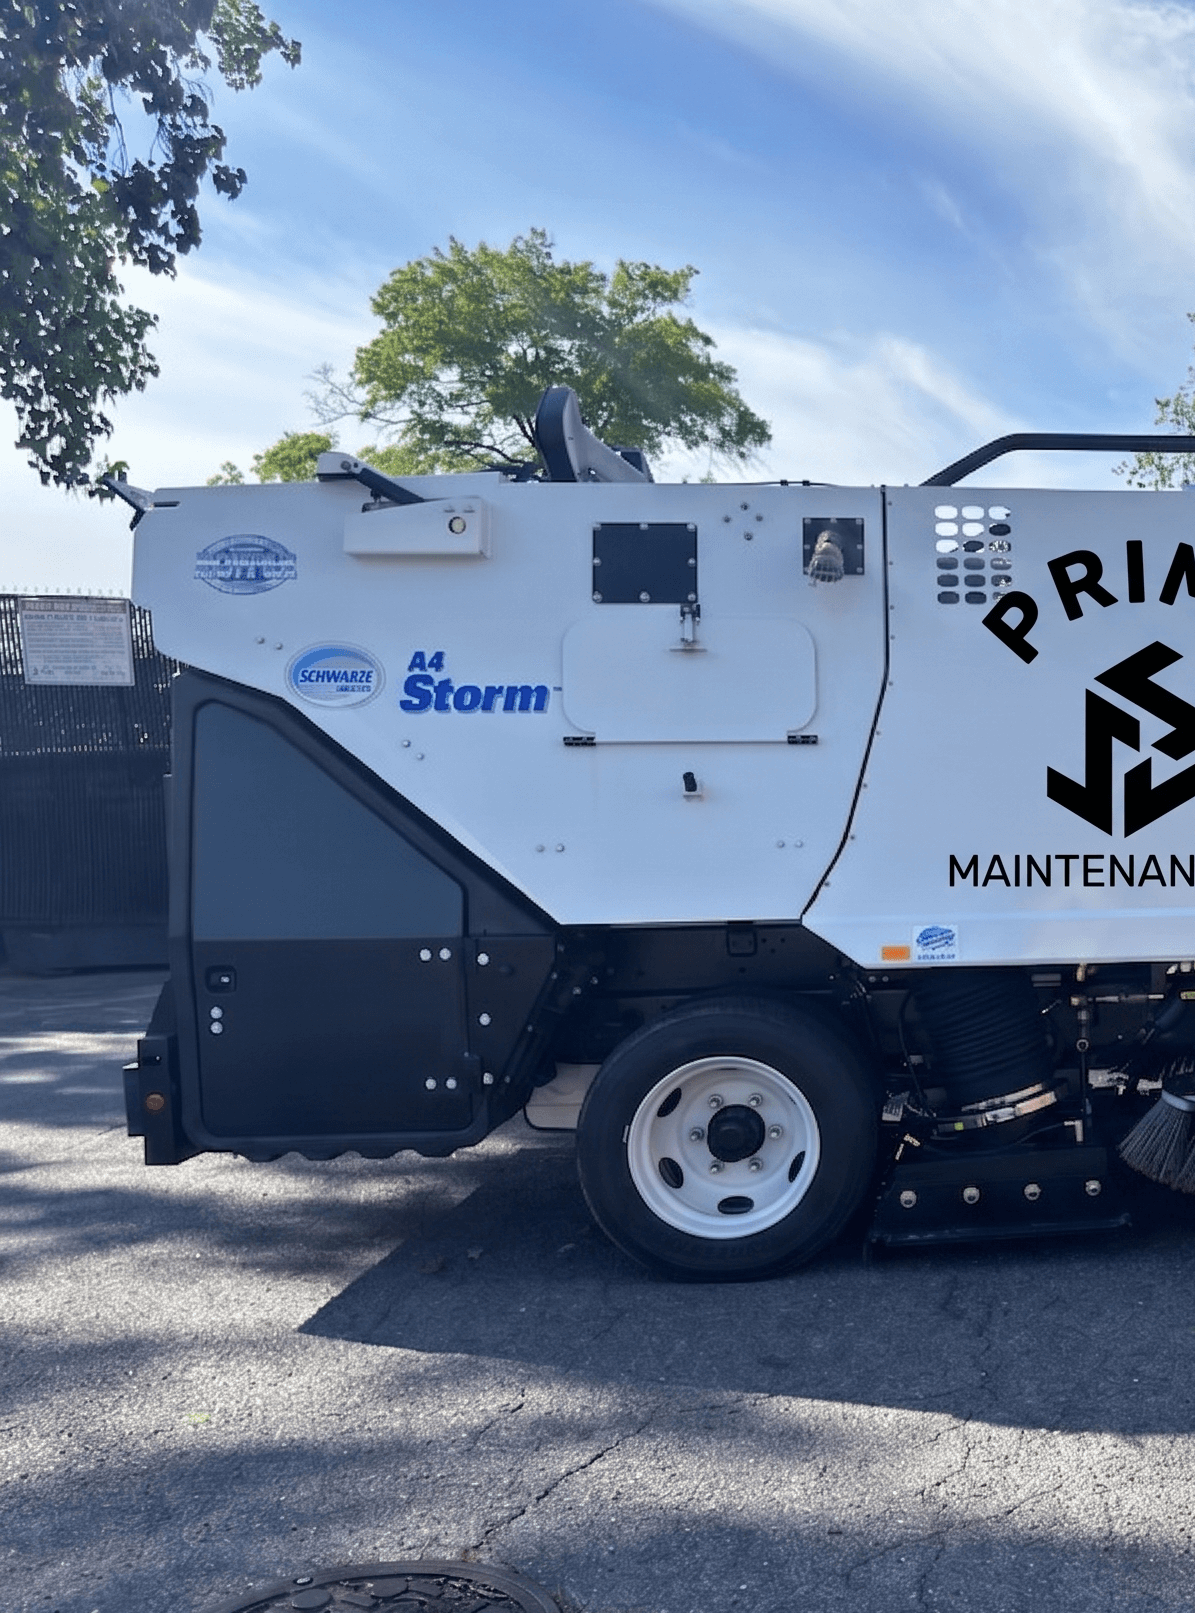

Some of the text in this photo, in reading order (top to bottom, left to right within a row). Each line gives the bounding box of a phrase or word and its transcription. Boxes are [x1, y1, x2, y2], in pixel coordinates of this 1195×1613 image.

[408, 651, 445, 672] A4
[299, 669, 374, 683] SCHWARZE
[400, 674, 550, 713] Storm
